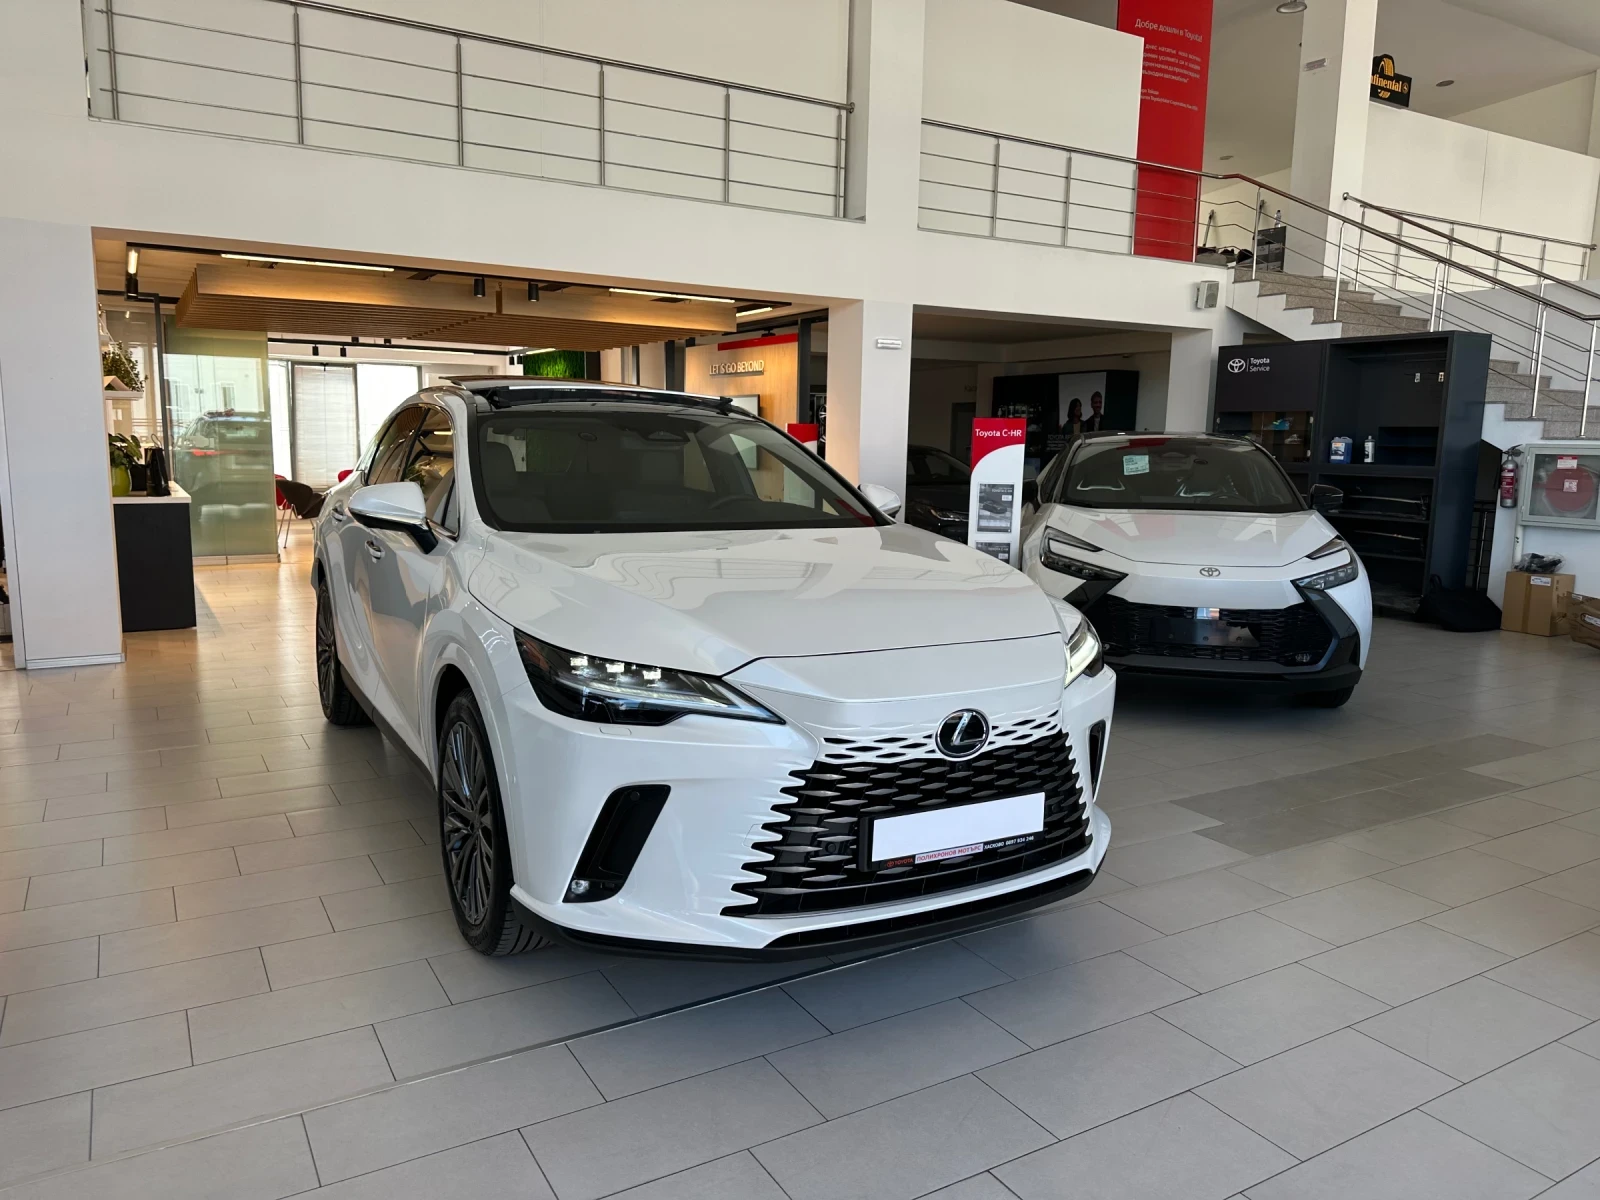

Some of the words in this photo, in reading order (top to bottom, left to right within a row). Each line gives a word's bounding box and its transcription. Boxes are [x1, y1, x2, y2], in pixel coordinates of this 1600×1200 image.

[1135, 18, 1158, 31] Добре
[1159, 24, 1179, 35] дошли
[725, 362, 737, 374] GO
[737, 359, 764, 373] BEYOND
[1250, 357, 1270, 365] Toyota
[975, 428, 1001, 438] Toyota
[1002, 429, 1022, 437] C-HR
[894, 857, 913, 865] TOYOTA
[916, 849, 957, 862] ПОЛИХРОНОВ
[957, 845, 982, 855] МОТЪРС
[984, 841, 1005, 850] ХАСКОВО
